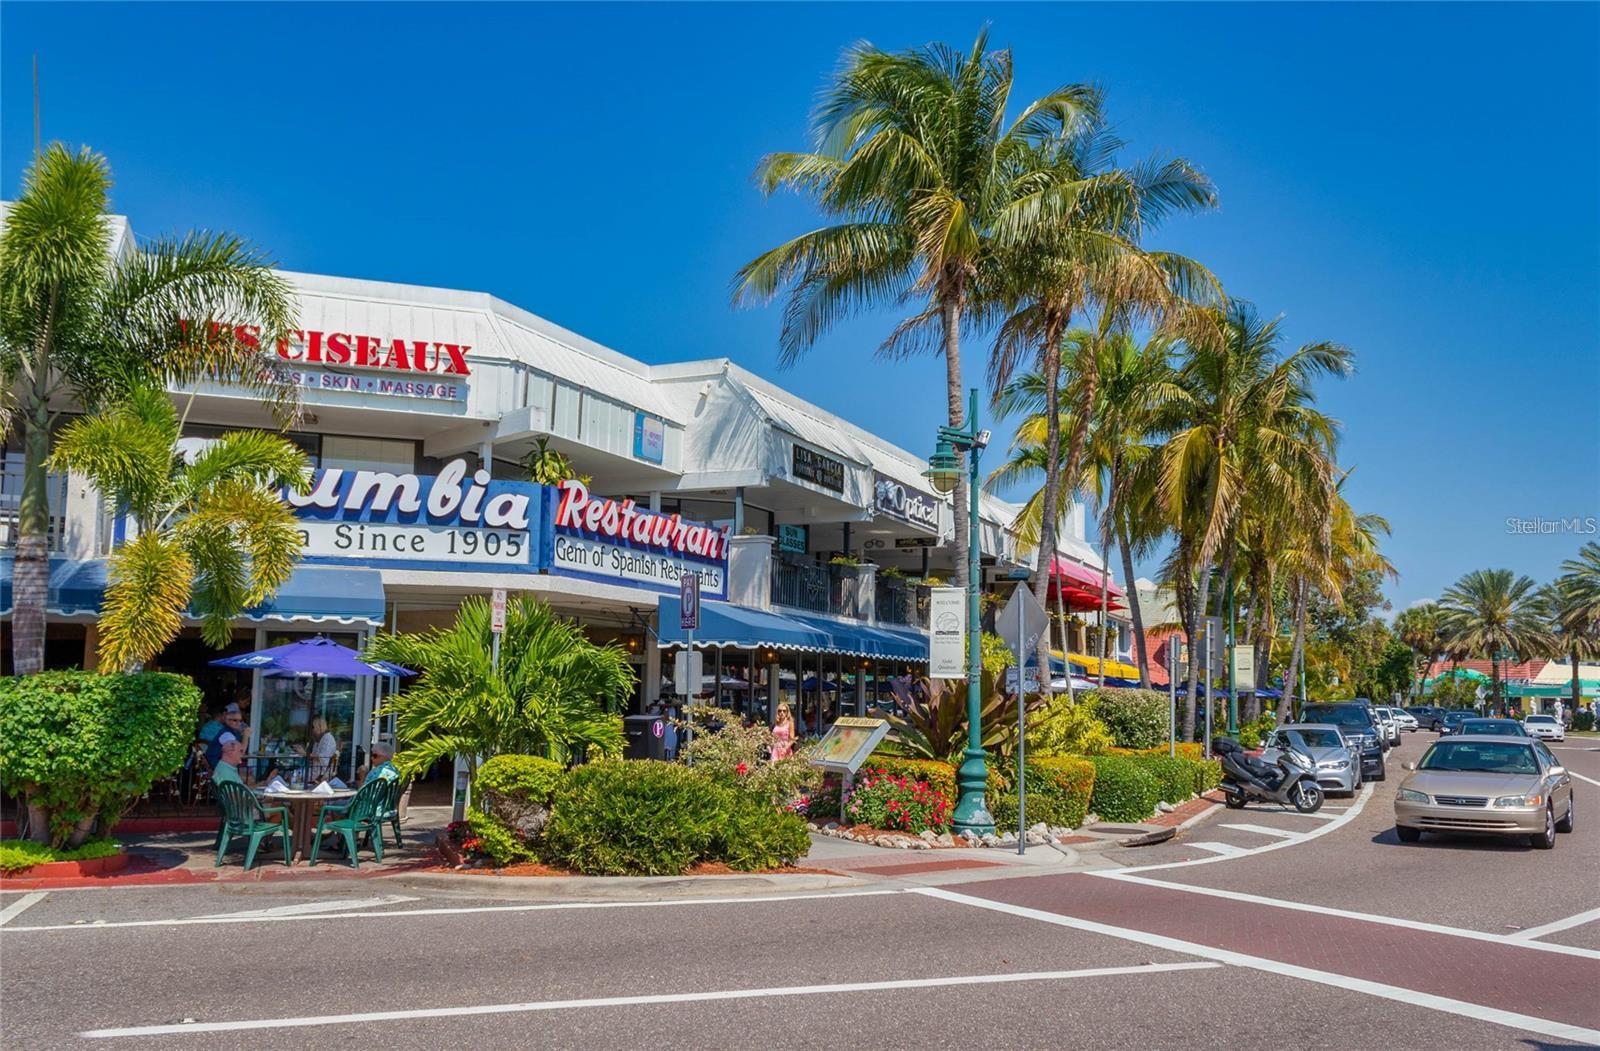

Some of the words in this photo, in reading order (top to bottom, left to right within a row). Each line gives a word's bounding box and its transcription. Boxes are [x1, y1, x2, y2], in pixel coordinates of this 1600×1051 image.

[276, 329, 472, 376] CISEAUX
[322, 375, 360, 390] SKIN
[380, 379, 457, 399] MASSAGE
[555, 479, 732, 561] Restaurant
[895, 484, 939, 526] Optical
[334, 523, 425, 553] Since
[447, 530, 522, 557] 1905
[555, 536, 587, 564] Gem
[592, 545, 608, 568] of
[611, 547, 658, 576] Spanish
